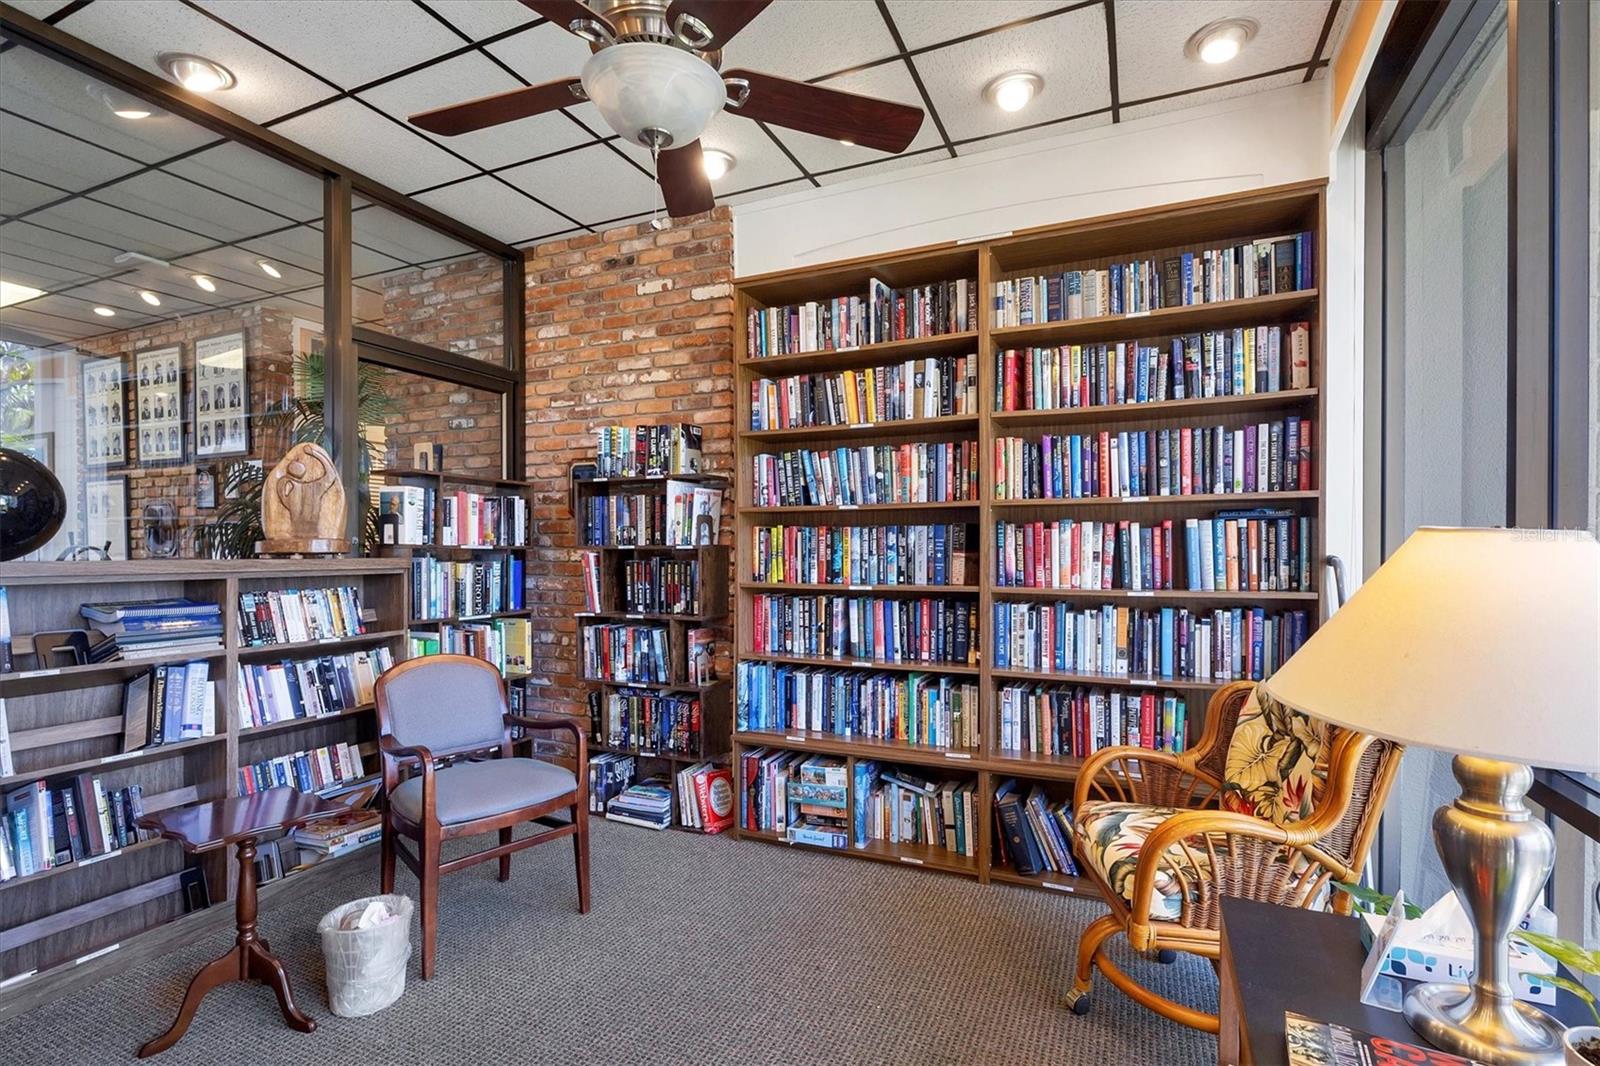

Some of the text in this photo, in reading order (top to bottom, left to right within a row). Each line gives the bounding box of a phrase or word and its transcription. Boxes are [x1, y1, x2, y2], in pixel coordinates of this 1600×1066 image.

[1016, 530, 1024, 571] JOHN SANDFORD
[474, 566, 484, 615] EUROPE
[154, 705, 162, 731] Dictionary
[1096, 706, 1104, 735] TRIANGLE
[1128, 707, 1138, 728] PACIFIC
